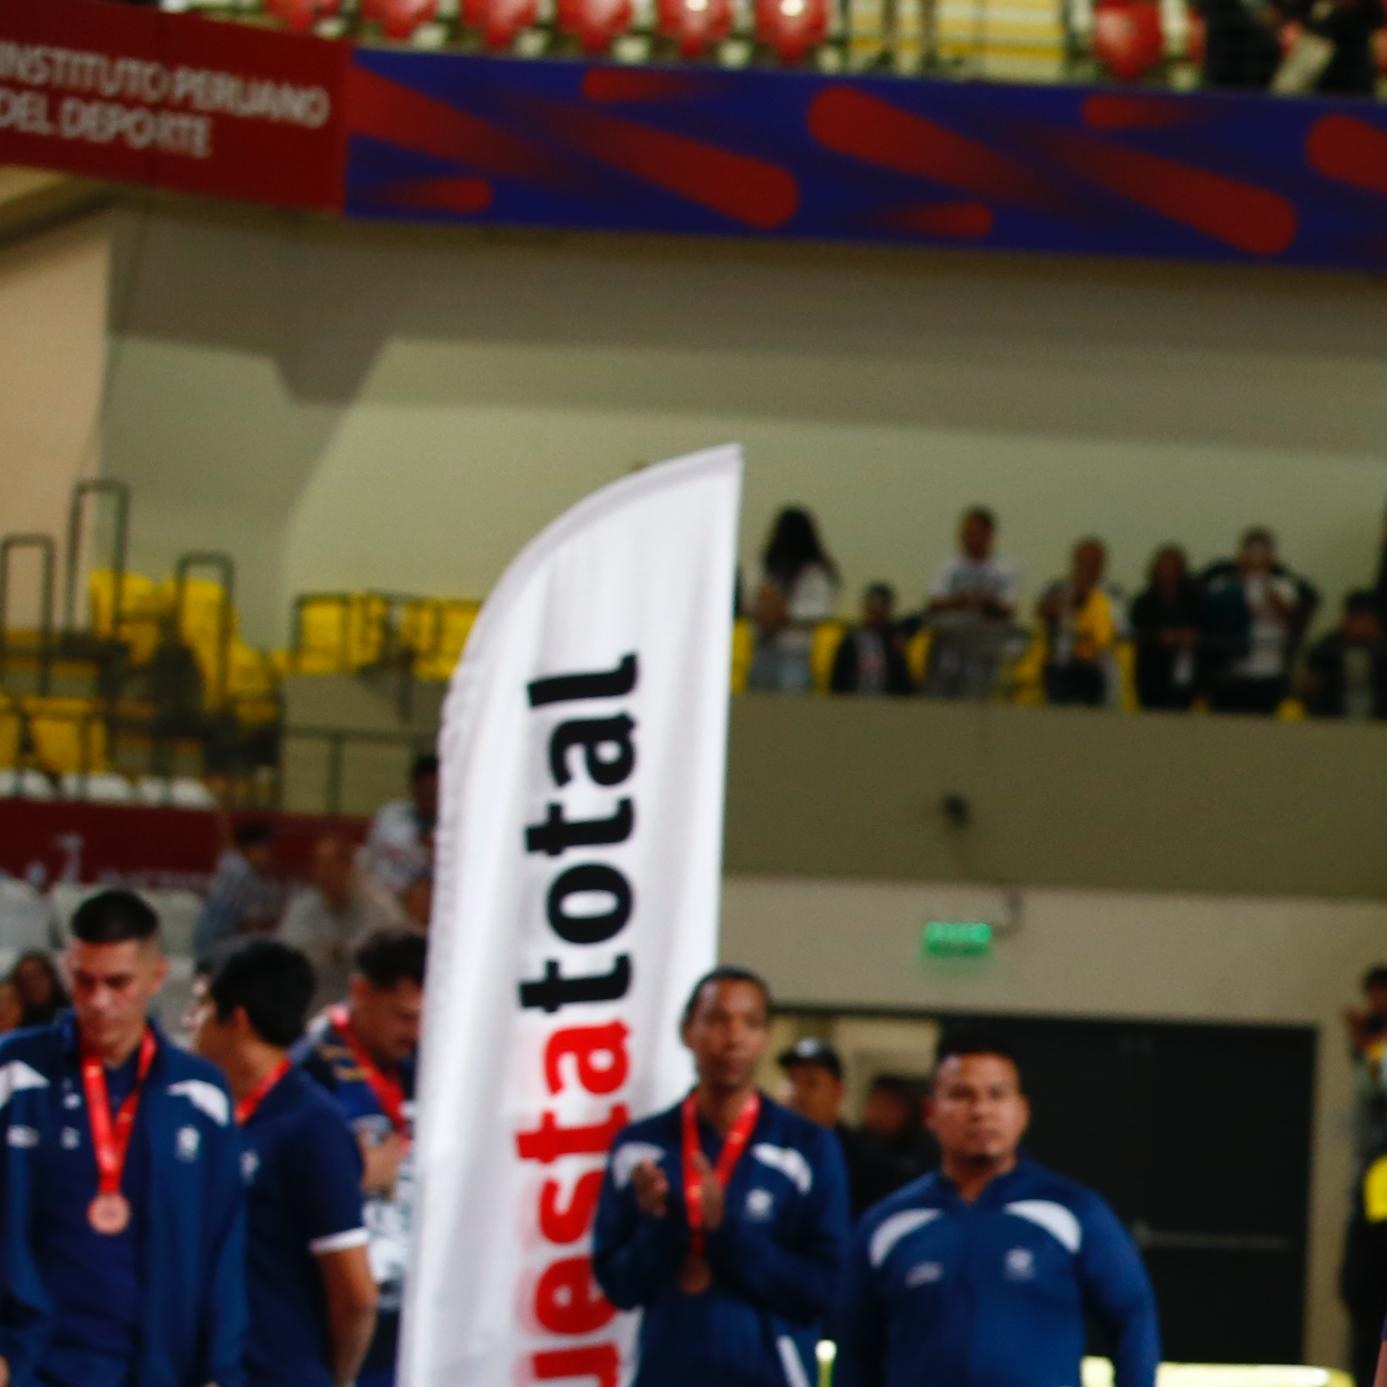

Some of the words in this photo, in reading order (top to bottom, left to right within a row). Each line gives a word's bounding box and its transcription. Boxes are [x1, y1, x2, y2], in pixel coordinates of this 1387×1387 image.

[0, 41, 168, 104] NSTITUTO
[172, 64, 331, 129] PERUANO
[59, 96, 212, 160] DEPORTE
